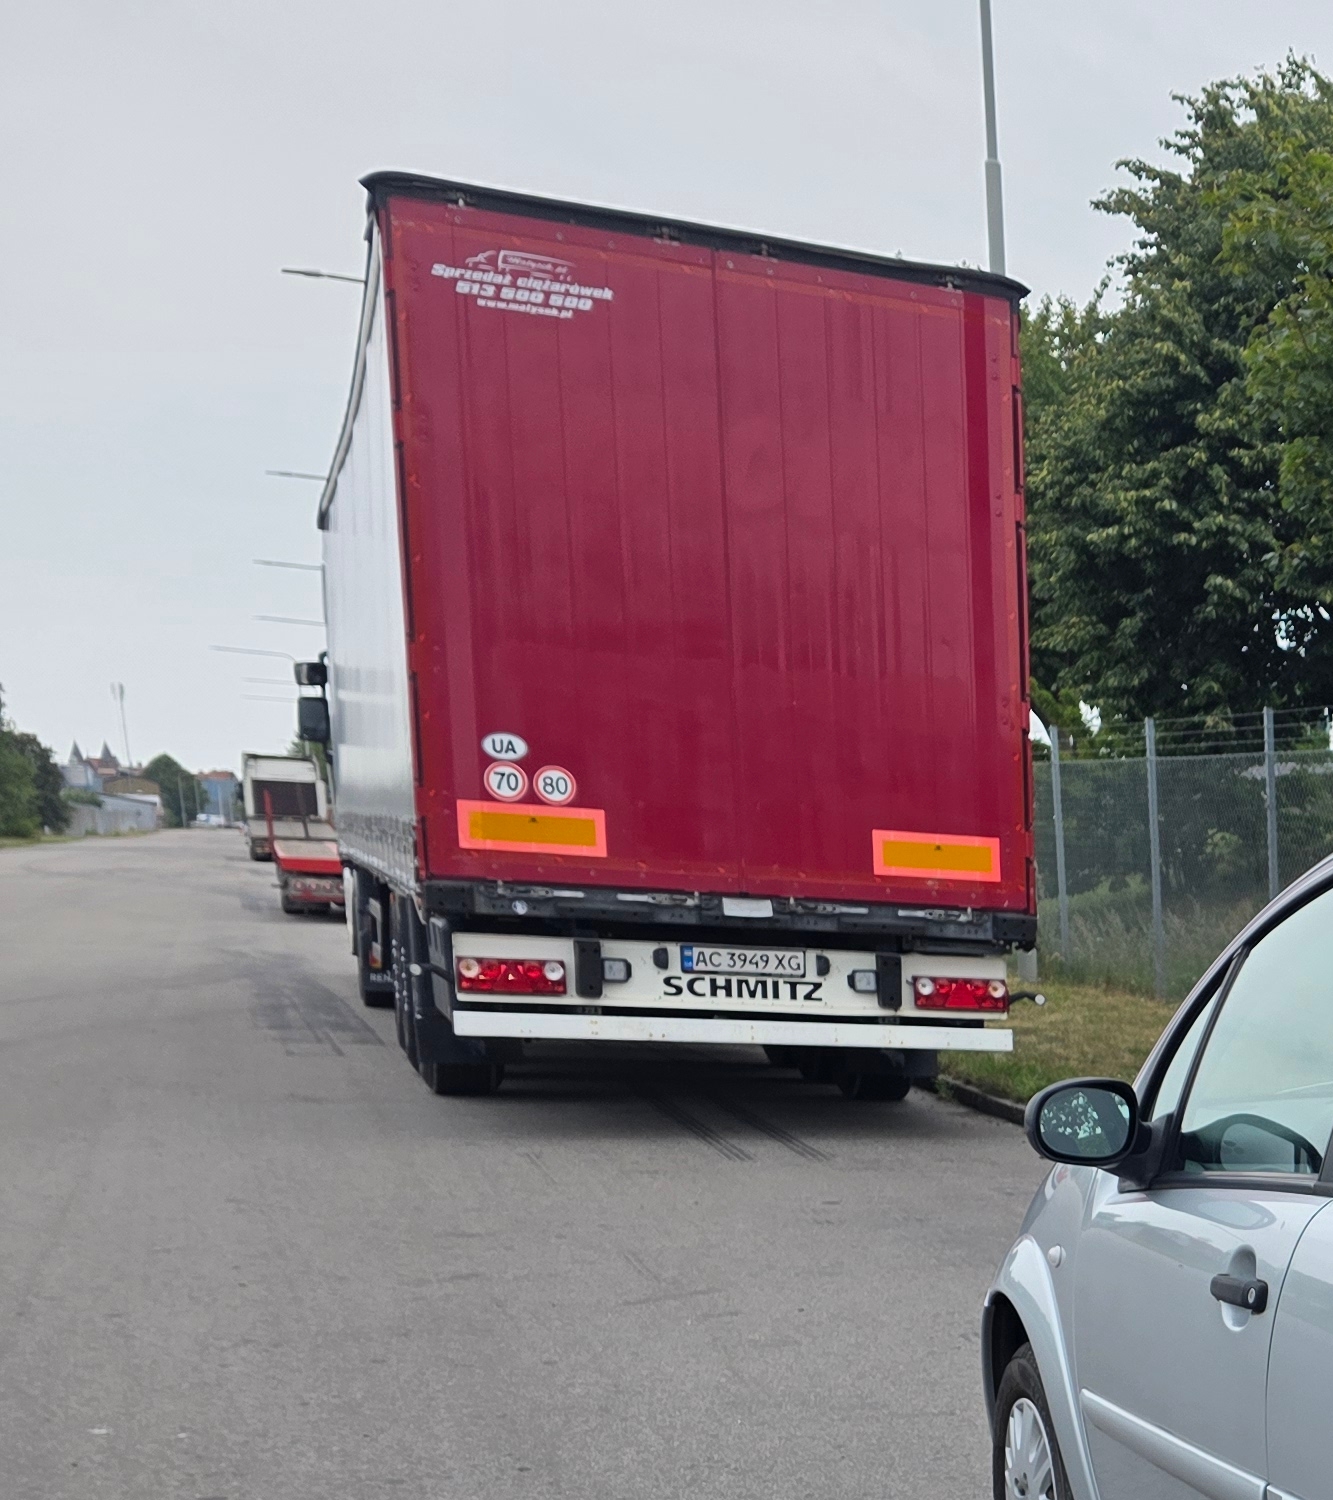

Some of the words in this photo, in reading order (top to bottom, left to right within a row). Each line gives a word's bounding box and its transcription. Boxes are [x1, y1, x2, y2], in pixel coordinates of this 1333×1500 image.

[491, 738, 517, 754] UA
[493, 771, 519, 791] 70
[542, 776, 568, 795] 80
[695, 951, 722, 968] AC
[727, 953, 770, 969] 3949
[774, 954, 801, 971] XG
[663, 976, 823, 1001] SCHMITZ
